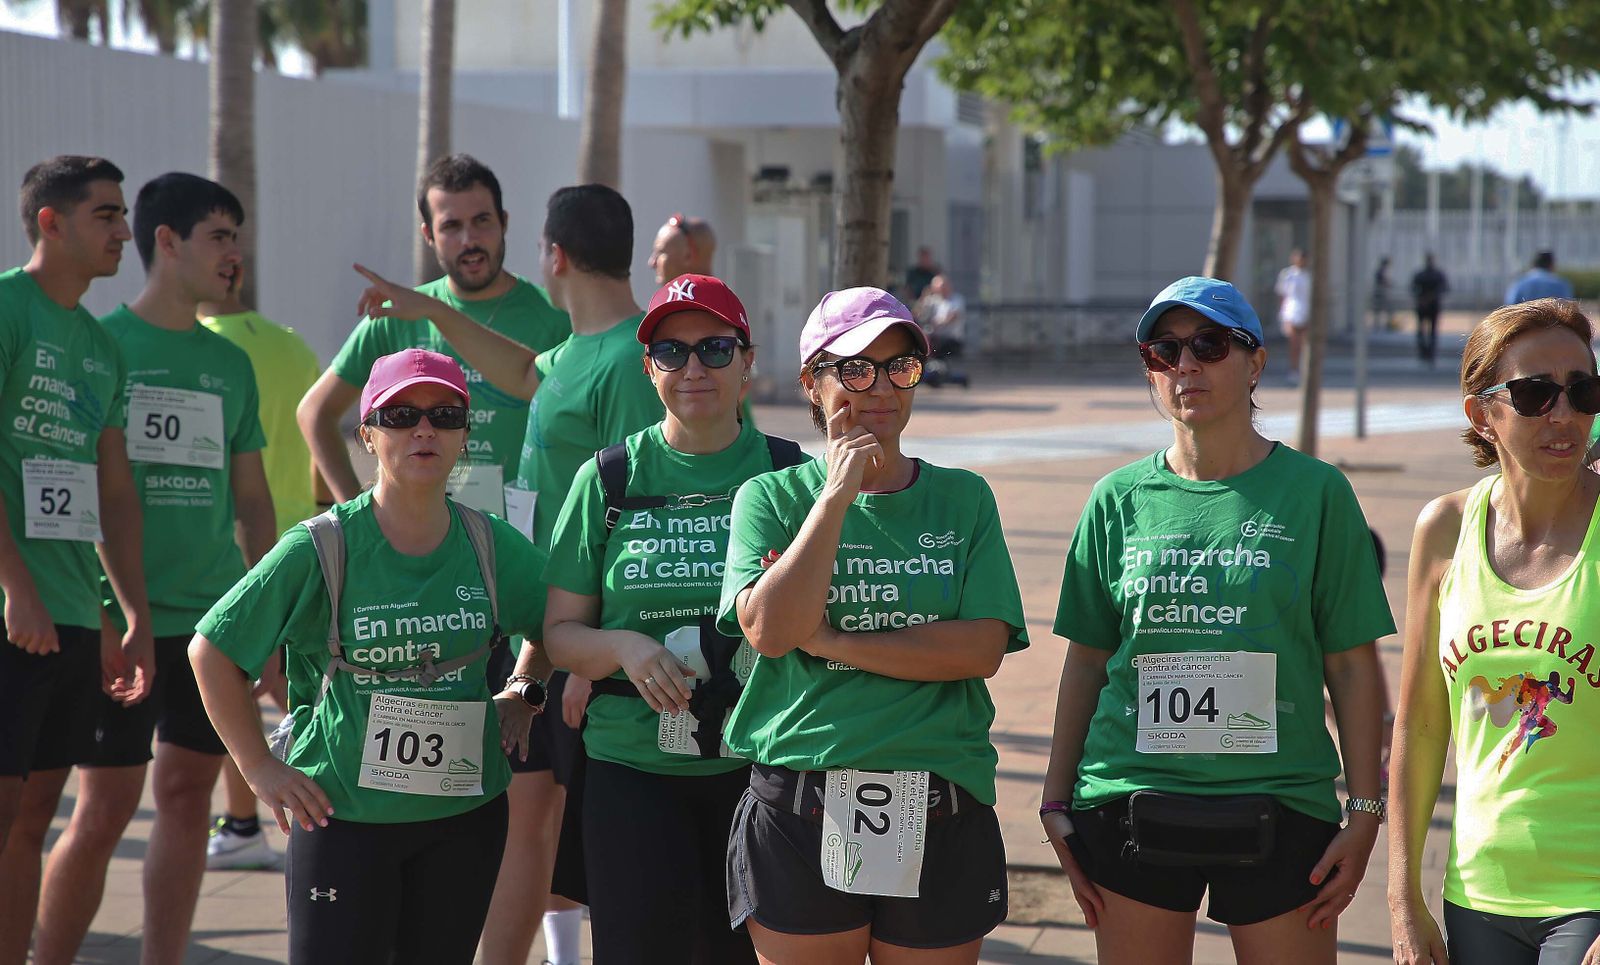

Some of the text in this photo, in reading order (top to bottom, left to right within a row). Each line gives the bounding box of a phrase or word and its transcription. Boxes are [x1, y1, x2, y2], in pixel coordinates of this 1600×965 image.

[36, 349, 55, 370] En
[14, 415, 37, 433] el
[39, 421, 87, 446] cáncer
[144, 413, 180, 440] 50
[40, 488, 71, 516] 52
[630, 511, 661, 530] En
[626, 537, 716, 554] contra
[842, 542, 873, 550] Algeciras
[847, 554, 954, 576] marcha
[1125, 544, 1270, 571] En marcha
[624, 558, 649, 580] el
[1123, 572, 1208, 598] contra
[357, 604, 380, 613] Carrera
[390, 601, 419, 610] Algeciras
[640, 607, 700, 620] Grazalema
[1148, 599, 1248, 624] cáncer
[354, 608, 486, 641] En marcha
[1142, 656, 1181, 666] Algeciras
[1196, 654, 1230, 662] marcha
[1142, 664, 1170, 672] contra
[1181, 663, 1212, 671] cáncer
[374, 704, 402, 714] contra
[414, 708, 444, 718] cáncer
[375, 696, 416, 708] Algeciras
[430, 702, 459, 711] marcha
[1146, 687, 1220, 724] 104
[668, 720, 676, 749] contra
[1148, 732, 1186, 740] SKODA
[374, 727, 444, 768] 103
[371, 768, 410, 780] SKODA
[910, 788, 916, 796] el
[908, 798, 916, 831] cáncer
[918, 802, 924, 812] en
[914, 815, 924, 850] marcha
